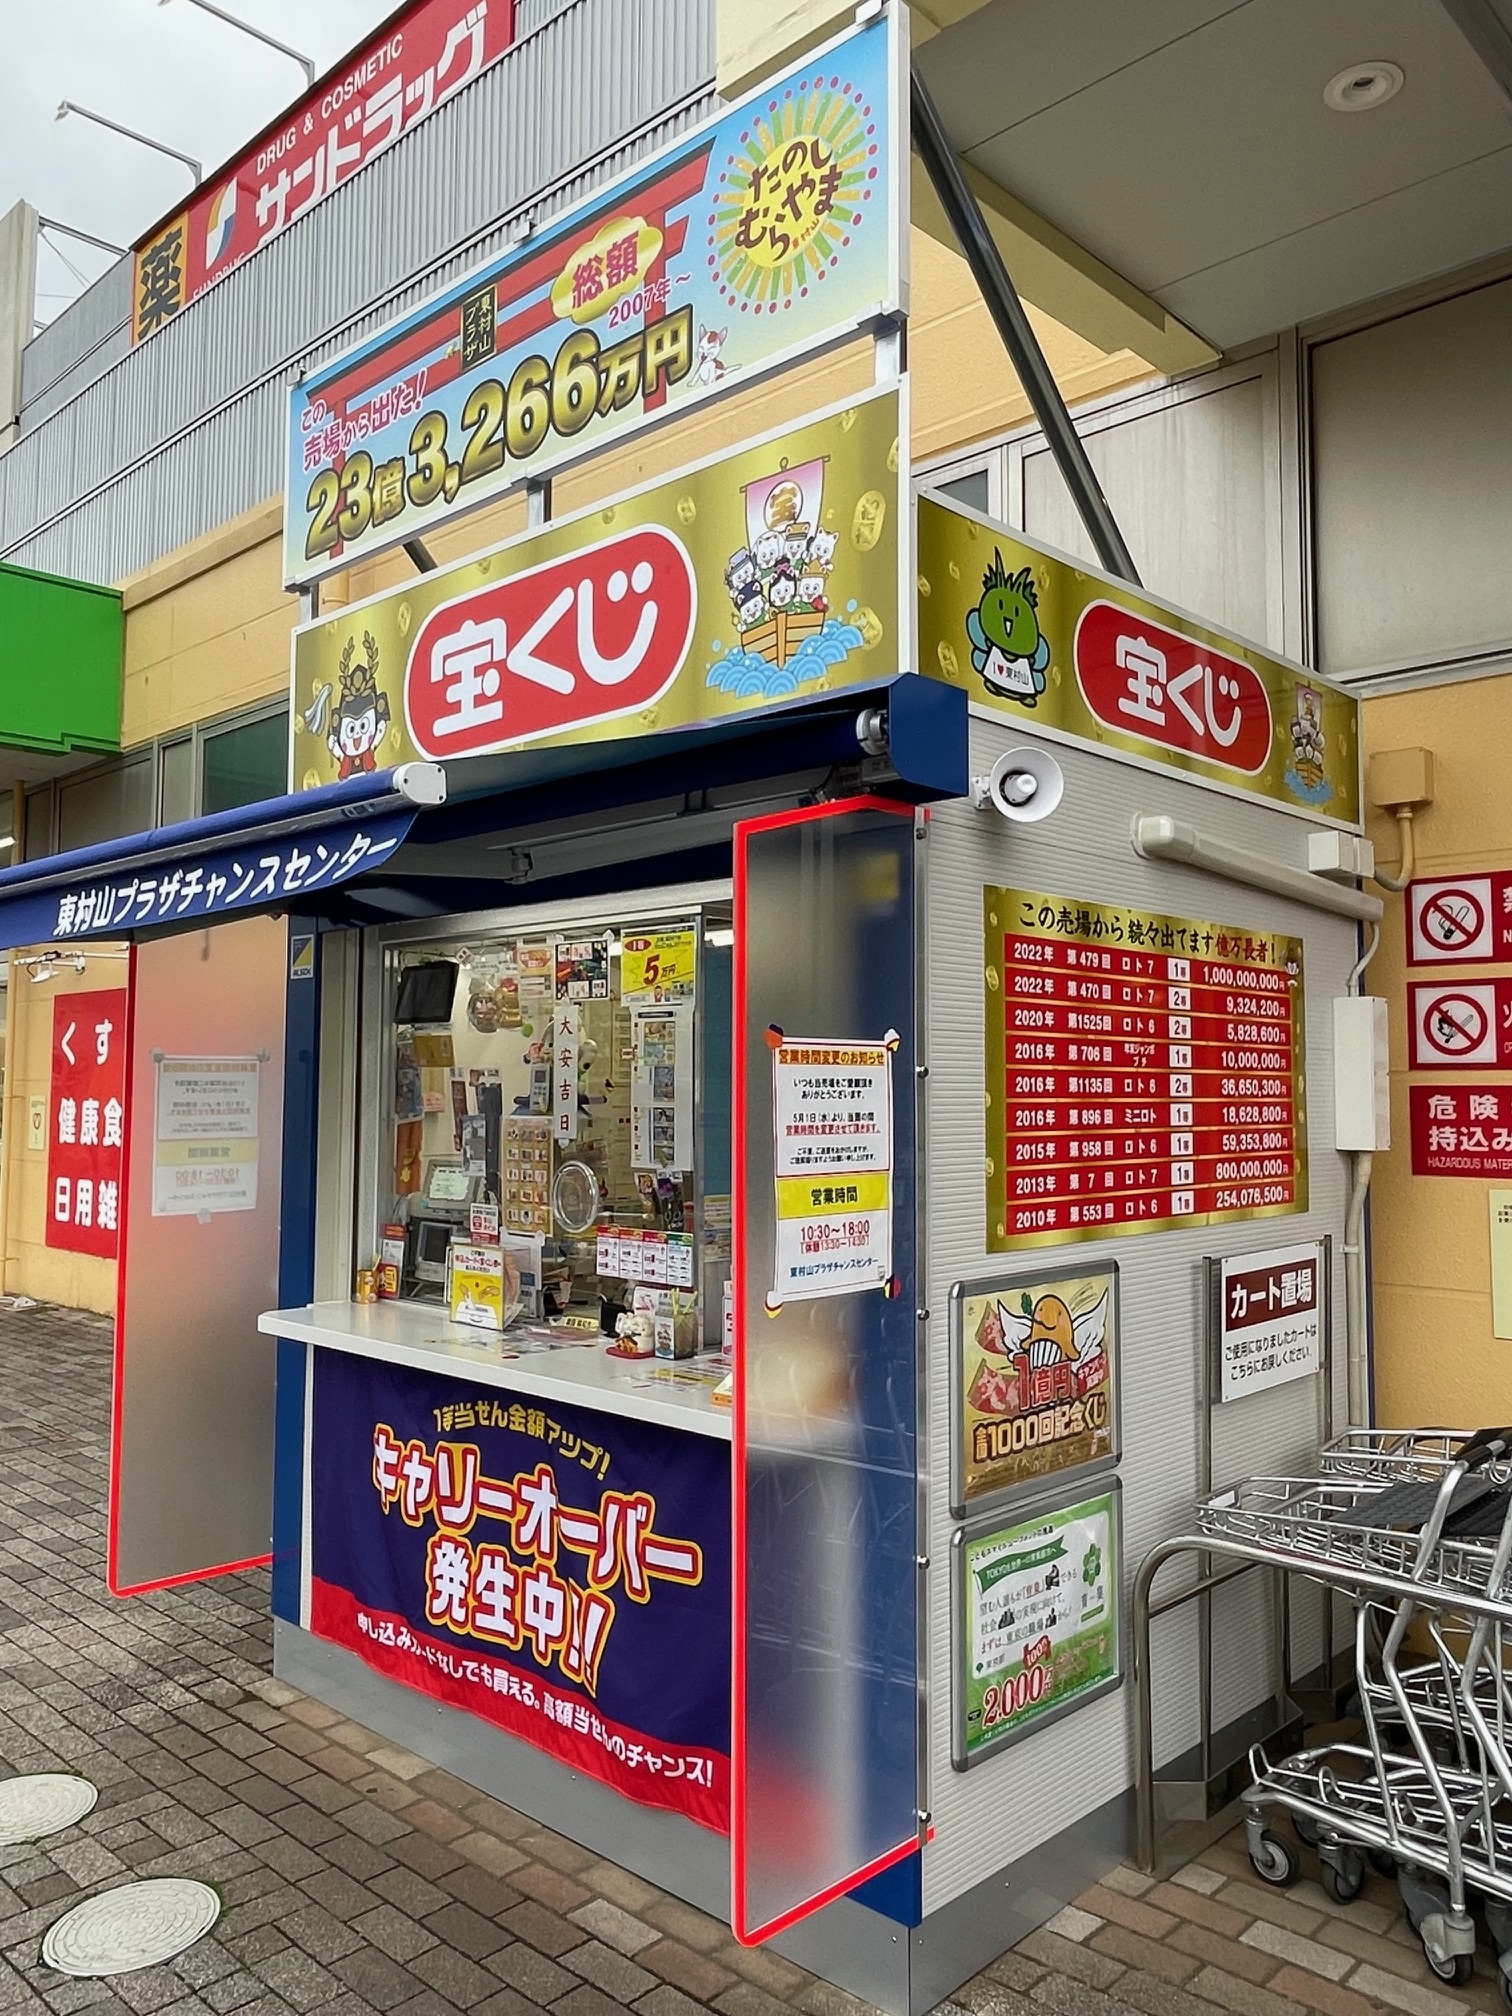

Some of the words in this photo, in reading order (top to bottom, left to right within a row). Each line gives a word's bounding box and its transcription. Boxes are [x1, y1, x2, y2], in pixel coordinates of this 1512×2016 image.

[256, 127, 297, 176] DRUG
[303, 112, 314, 134] &
[321, 33, 404, 119] COSMETIC
[256, 5, 489, 247] サンドラッグ
[748, 138, 833, 203] たのし
[735, 163, 843, 262] むらやま
[138, 226, 182, 340] 薬
[572, 230, 639, 309] 総額
[463, 302, 479, 362] プラザ
[478, 294, 492, 354] 東村山
[301, 399, 327, 433] この
[305, 303, 694, 561] 23億3,266万円
[431, 561, 658, 738] 宝くじ
[1116, 634, 1242, 748] 宝くじ
[53, 833, 399, 937] 東村山プラザチャンスセンター
[1014, 943, 1054, 962] 2022年
[1014, 976, 1054, 995] 2022年
[1015, 1009, 1054, 1027] 2020年
[558, 1015, 574, 1132] 大安吉日
[779, 1049, 885, 1065] 営業時間変更のお知らせ
[1015, 1043, 1055, 1060] 2016年
[1015, 1076, 1055, 1093] 2016年
[1428, 1095, 1512, 1120] 危険
[58, 1097, 122, 1148] 健康食
[1016, 1109, 1055, 1126] 2016年
[1125, 1108, 1157, 1124] ミニロト
[1016, 1142, 1056, 1160] 2015年
[1428, 1157, 1481, 1169] HAZARDOUS
[55, 1177, 117, 1230] 日用雑
[811, 1186, 858, 1206] 営業時間
[1016, 1175, 1056, 1195] 2013年
[1016, 1208, 1056, 1229] 2010年
[1231, 1268, 1312, 1319] カート置場
[1225, 1325, 1317, 1361] ご使用になりましたカートは
[1014, 1354, 1071, 1410] 1億円
[433, 1400, 611, 1481] 1等当せん金額アップ!
[374, 1428, 698, 1600] キャリーオーバー
